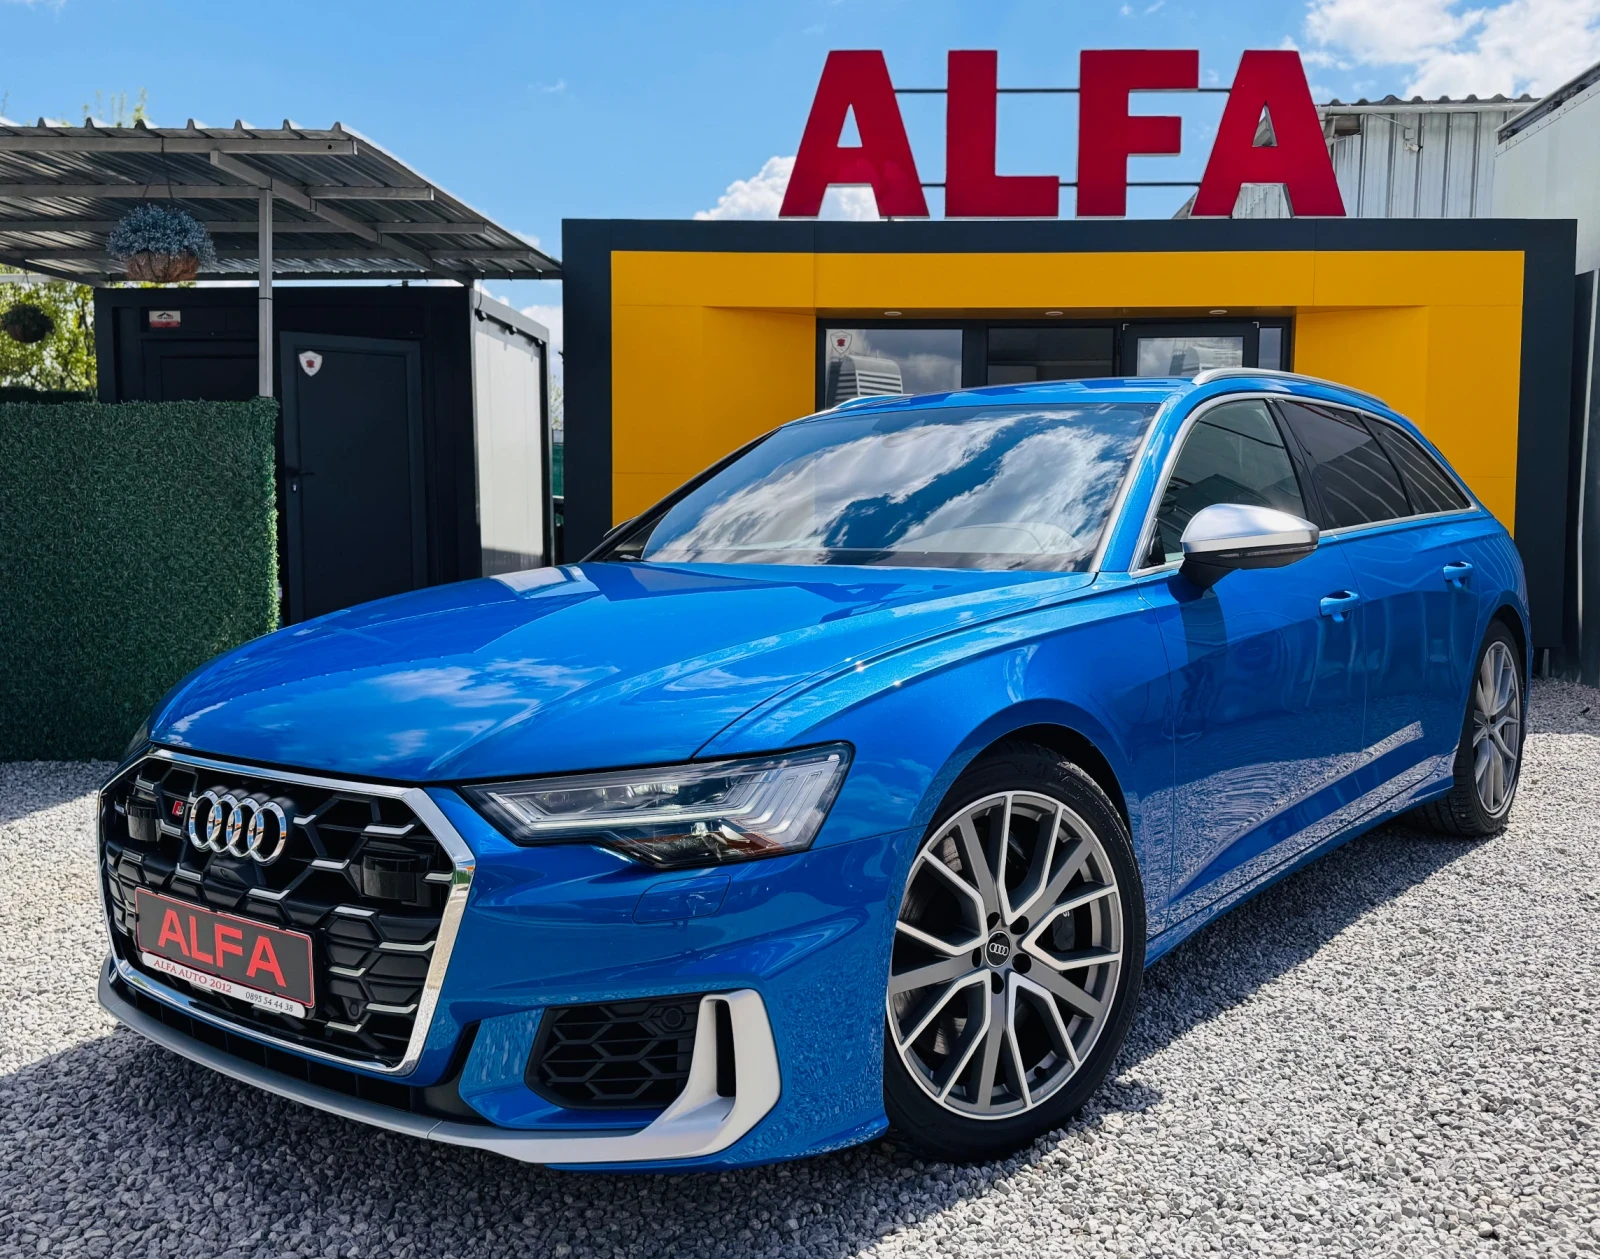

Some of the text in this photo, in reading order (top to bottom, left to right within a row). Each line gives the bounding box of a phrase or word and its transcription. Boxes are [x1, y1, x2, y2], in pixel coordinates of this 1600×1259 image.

[779, 49, 1346, 218] ALFA
[153, 959, 232, 994] ALFA AUTO 2012
[157, 908, 287, 988] ALFA
[245, 991, 294, 1012] 0895 54 44 38
